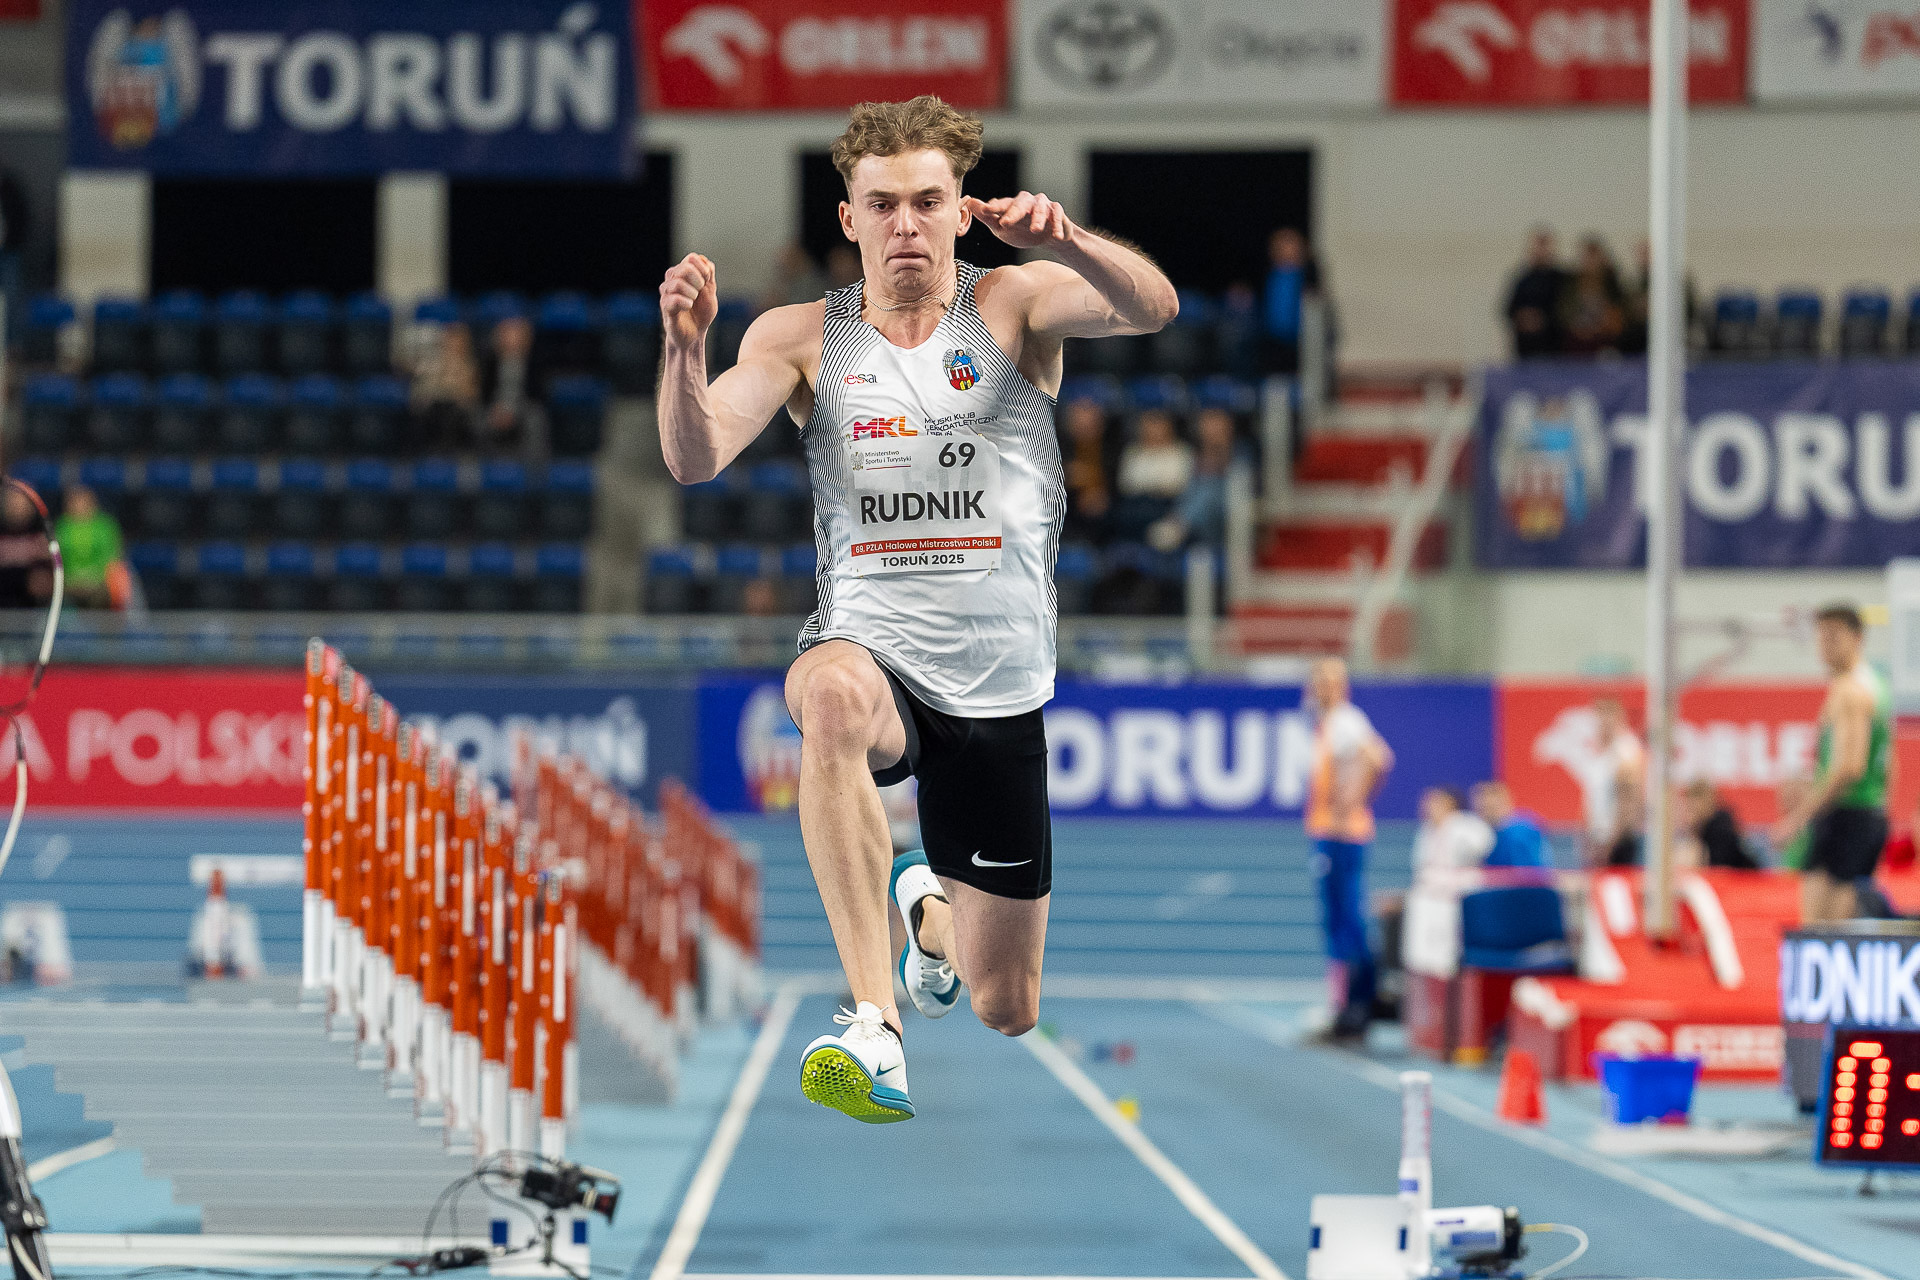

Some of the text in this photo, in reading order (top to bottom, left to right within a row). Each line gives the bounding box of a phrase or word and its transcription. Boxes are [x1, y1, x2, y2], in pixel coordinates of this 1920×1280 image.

[1528, 8, 1731, 66] ORLN
[206, 2, 617, 131] TORUŃ
[853, 415, 918, 441] MKL
[953, 411, 976, 421] KLUB
[865, 450, 900, 458] Ministerstwo
[865, 457, 883, 465] Sportu
[887, 455, 912, 464] Turystyki
[938, 442, 976, 468] 69
[860, 490, 987, 525] RUDNIK
[866, 543, 884, 552] PZLA
[885, 541, 918, 550] Halowe
[919, 540, 970, 549] Mistrzostwa
[972, 538, 997, 547] Polski
[881, 552, 965, 568] TORUŃ 2025
[1046, 707, 1310, 809] ORU
